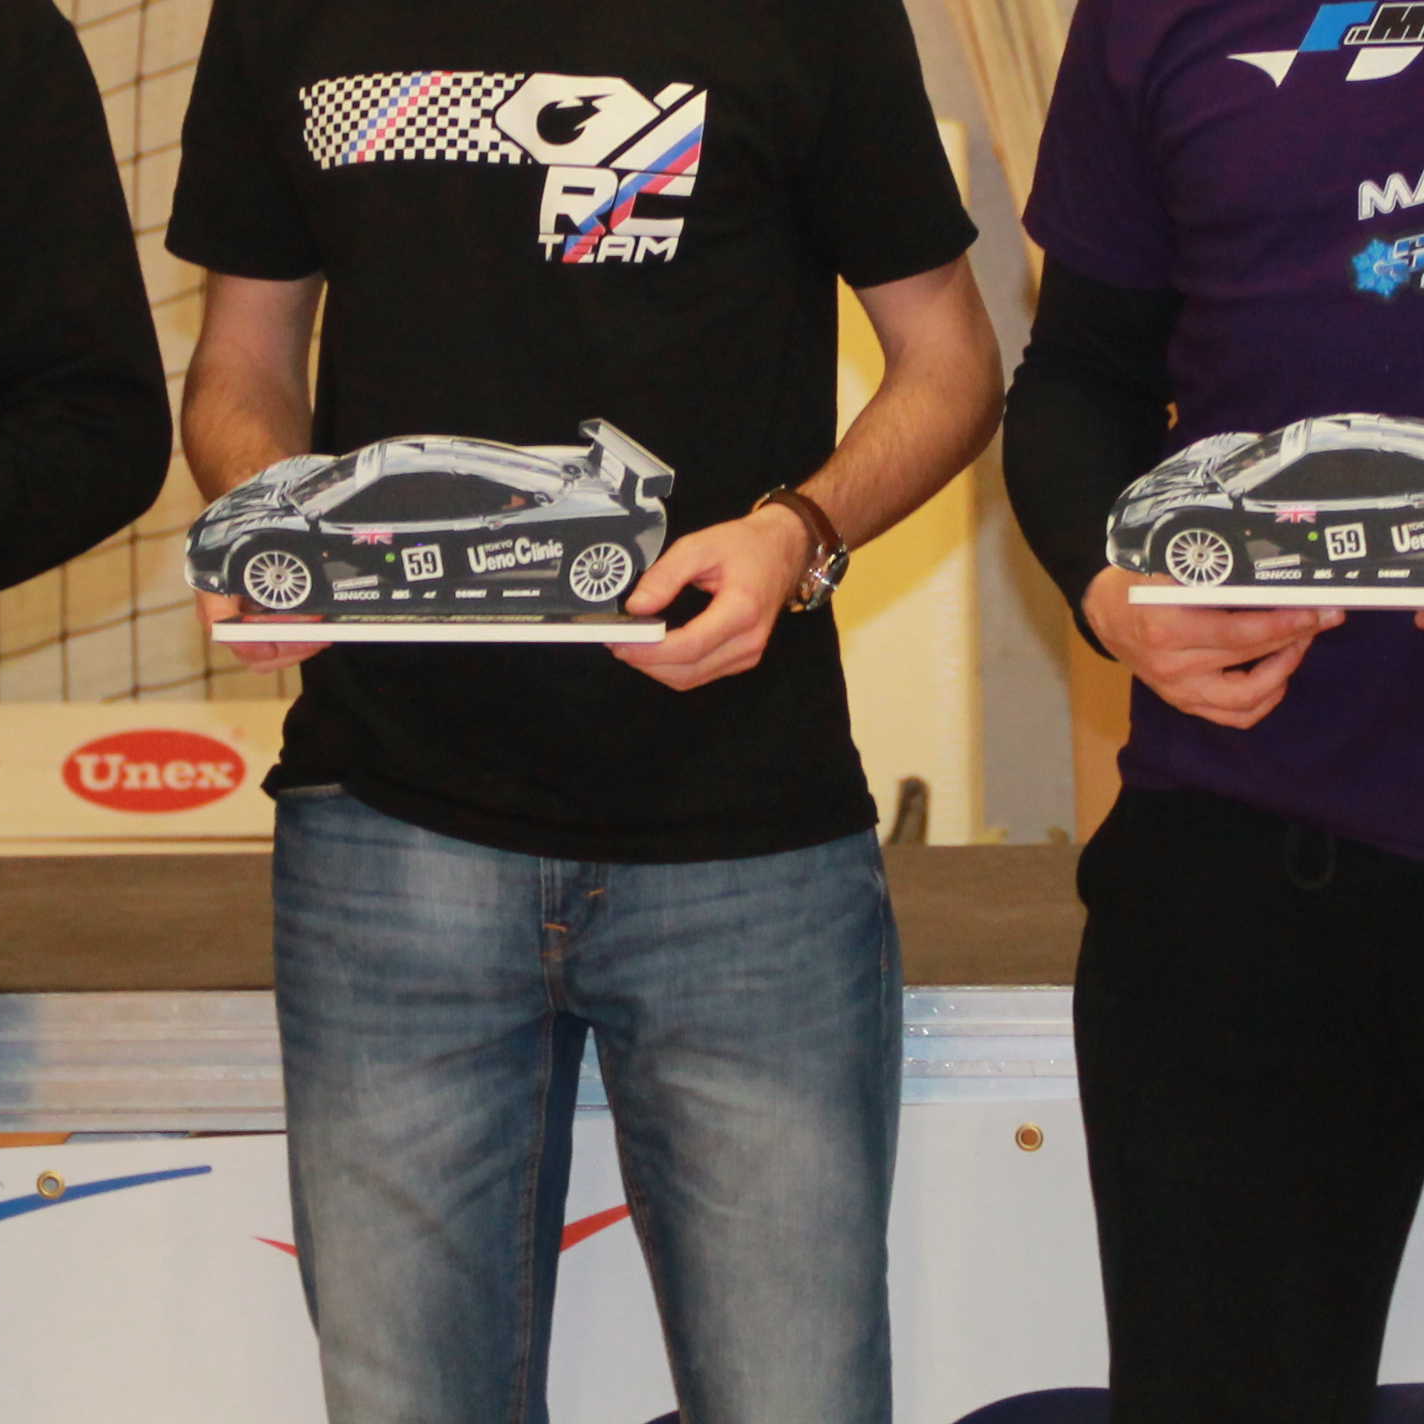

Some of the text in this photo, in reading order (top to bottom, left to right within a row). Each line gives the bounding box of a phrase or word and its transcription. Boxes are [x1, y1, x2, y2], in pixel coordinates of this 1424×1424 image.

[537, 234, 680, 263] TEAM
[467, 537, 564, 573] Ueno Clinic
[1330, 530, 1361, 555] 59
[407, 551, 438, 576] 59
[75, 754, 235, 792] Unex
